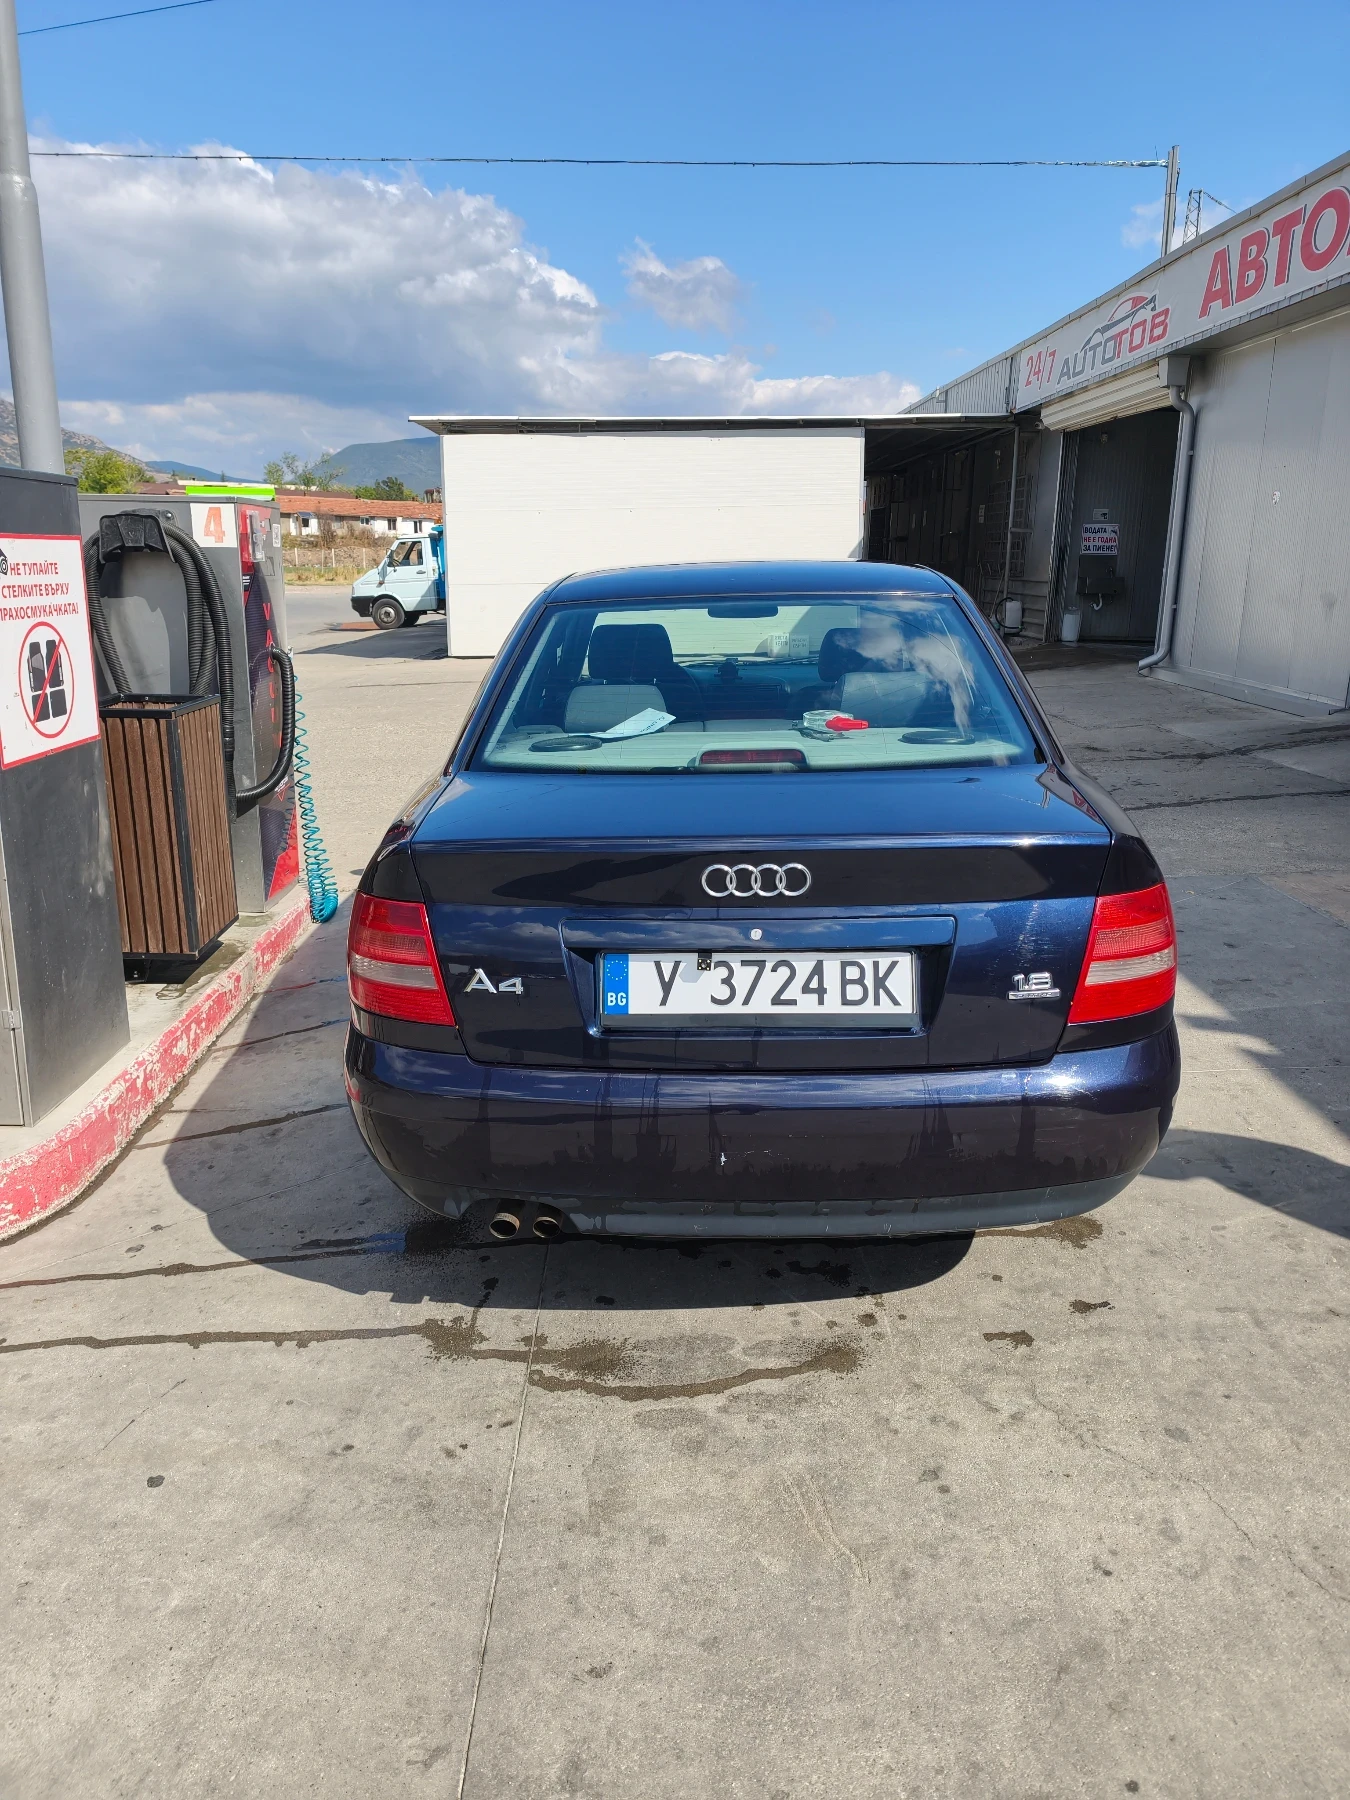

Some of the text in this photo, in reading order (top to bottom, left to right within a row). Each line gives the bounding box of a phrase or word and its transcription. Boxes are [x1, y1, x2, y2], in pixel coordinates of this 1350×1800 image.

[1198, 186, 1350, 319] АВТО
[1025, 346, 1057, 390] 24/7
[203, 506, 226, 543] 4
[9, 559, 59, 576] НЕ ТУПАЙТЕ
[1, 582, 70, 599] СТЕЛКИТЕ ВЪРХУ
[463, 967, 524, 995] A4
[710, 959, 828, 1007] 3724
[840, 960, 902, 1007] BK
[1012, 971, 1053, 991] 1.8
[607, 992, 627, 1006] BG
